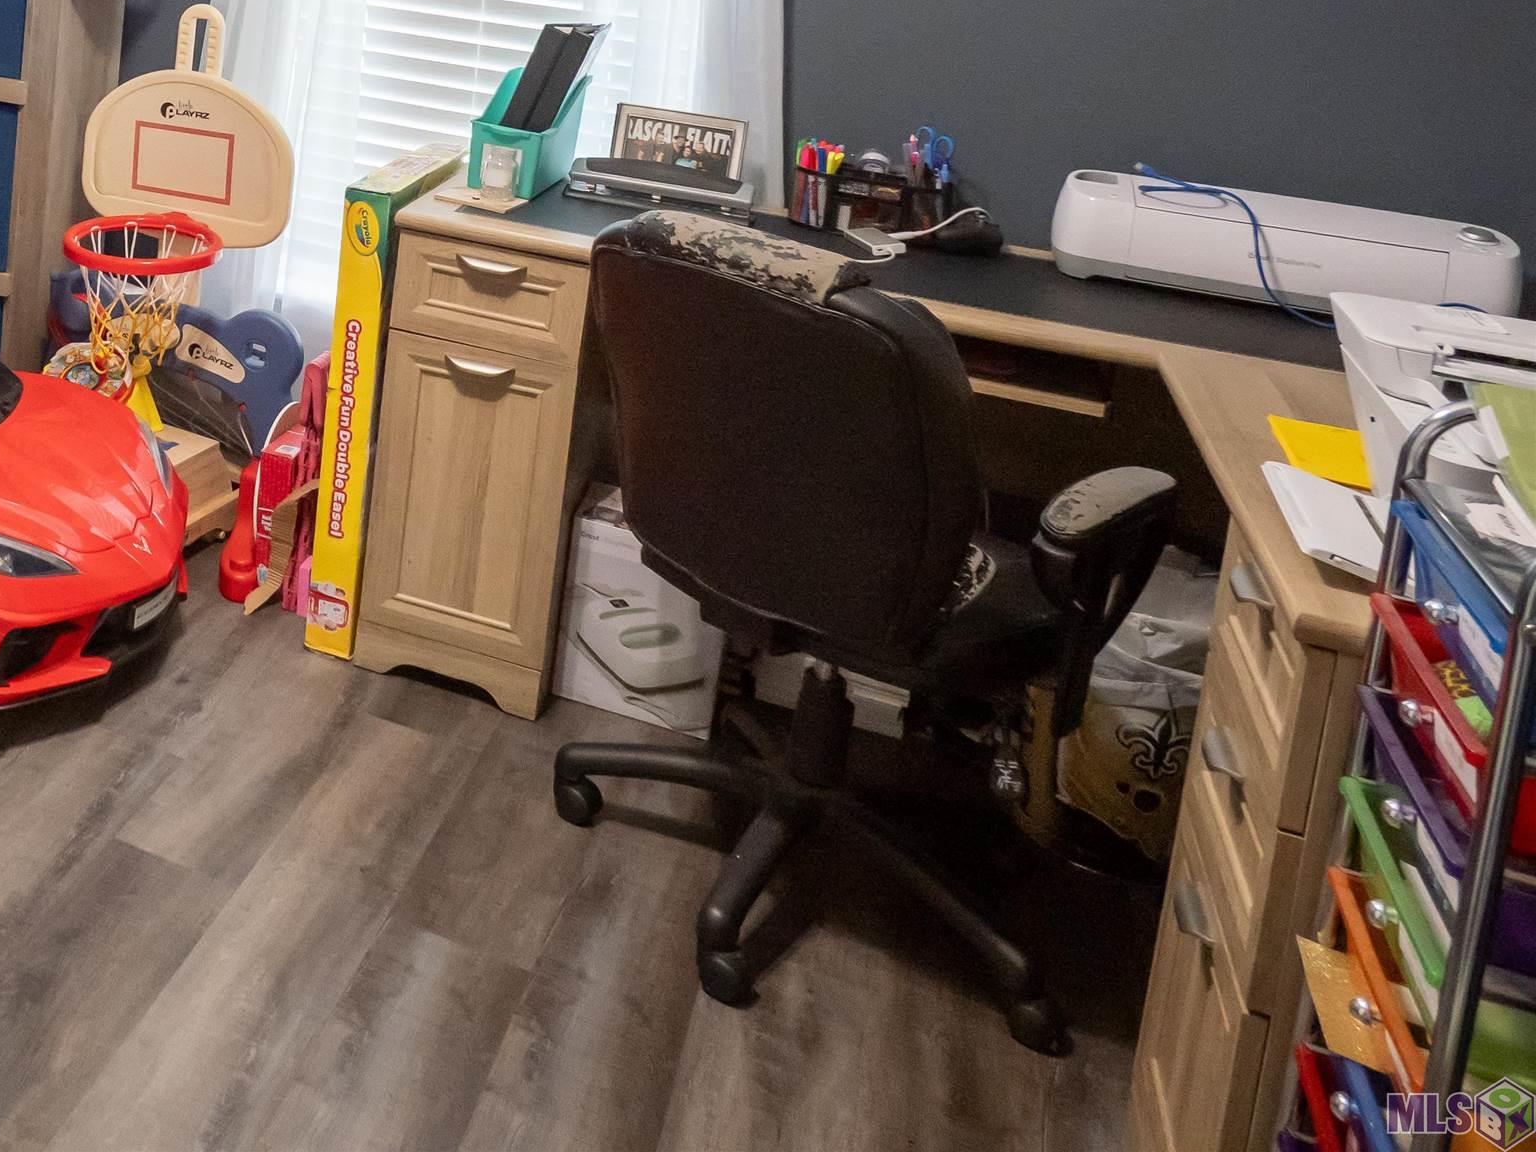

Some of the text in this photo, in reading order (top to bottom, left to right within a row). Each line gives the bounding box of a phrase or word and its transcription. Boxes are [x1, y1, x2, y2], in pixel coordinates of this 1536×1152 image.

[361, 209, 372, 246] Crayola
[329, 319, 362, 538] Creative Fun Double Easel
